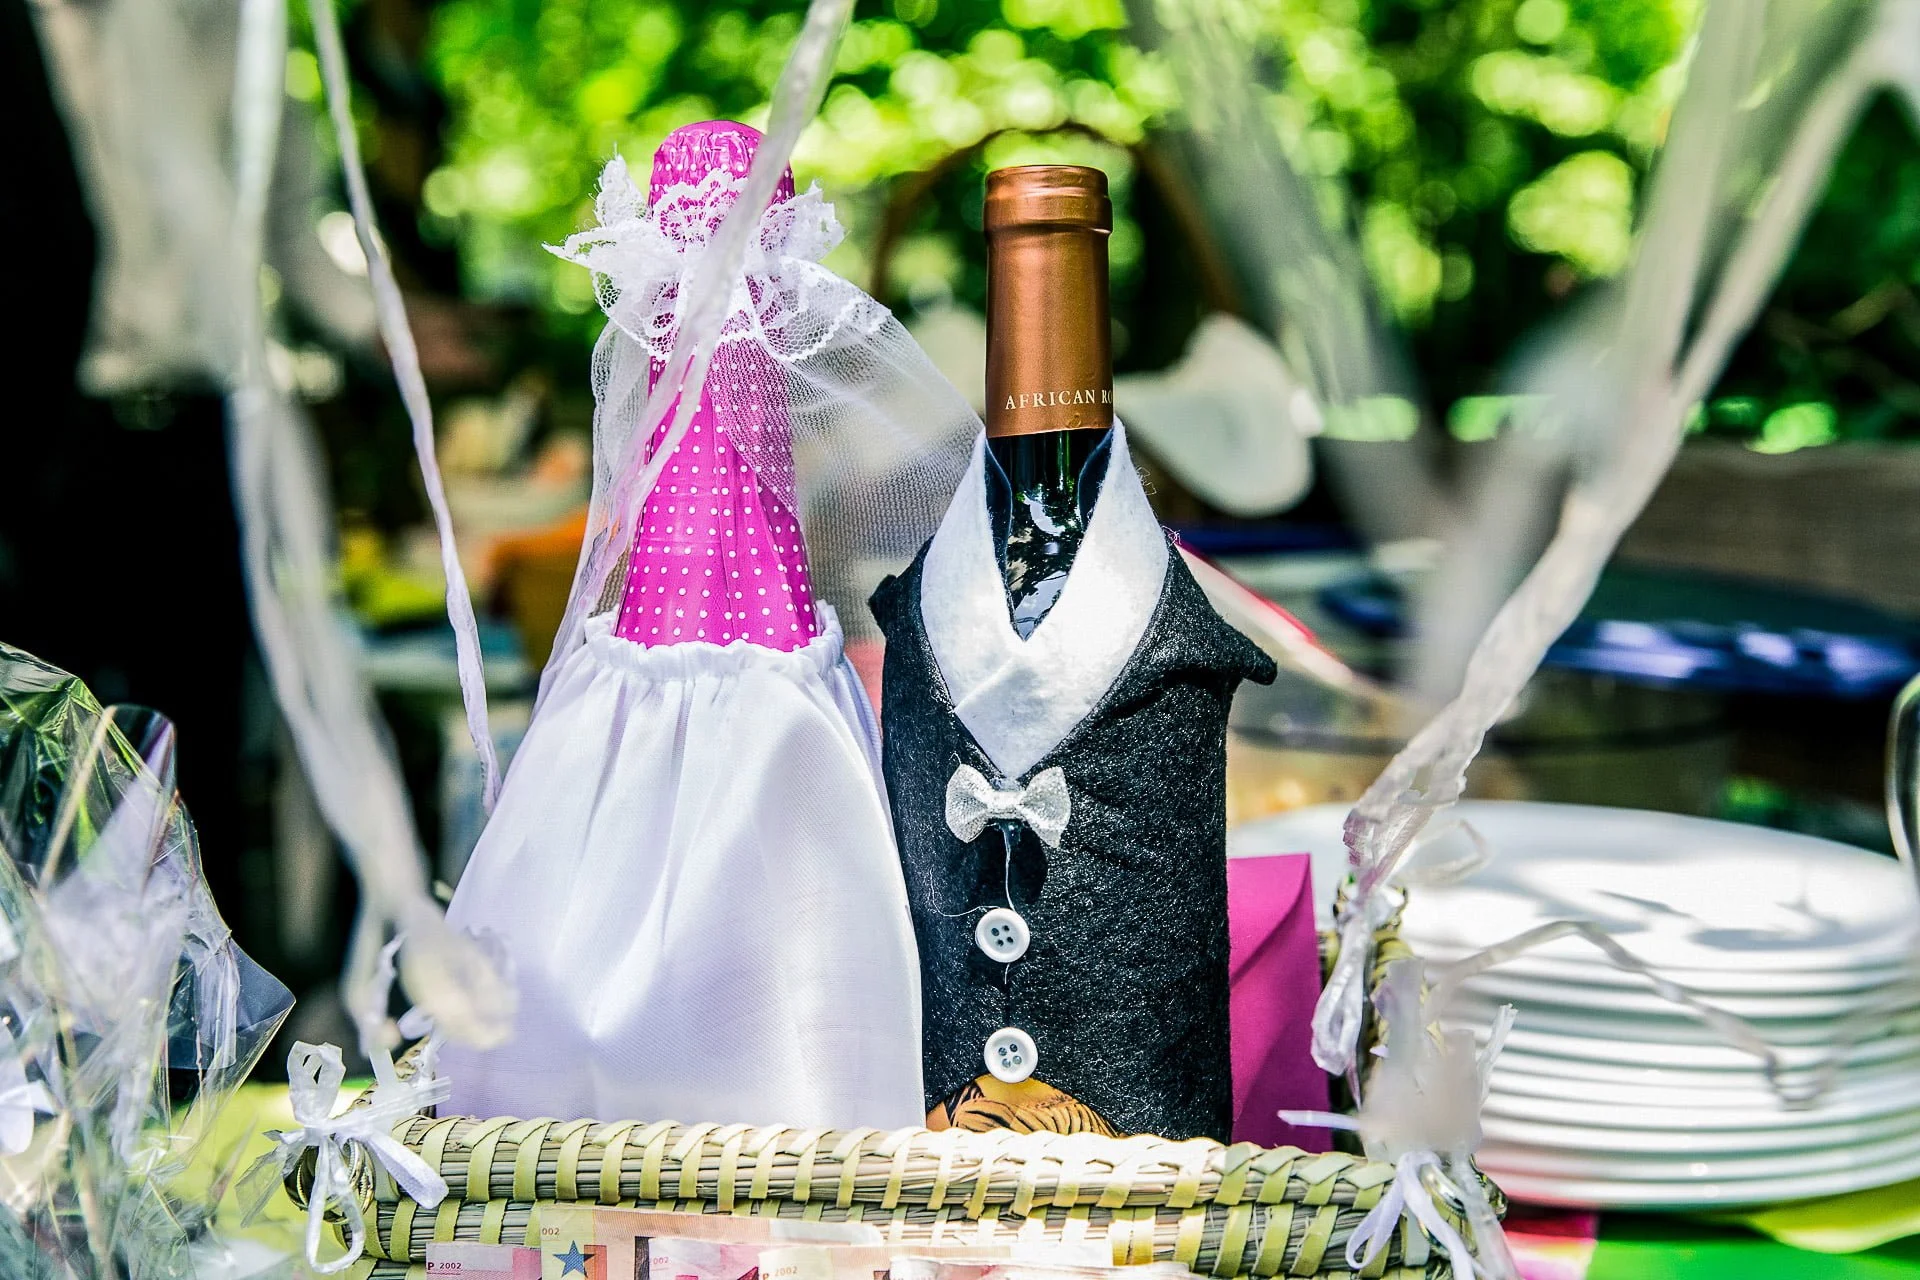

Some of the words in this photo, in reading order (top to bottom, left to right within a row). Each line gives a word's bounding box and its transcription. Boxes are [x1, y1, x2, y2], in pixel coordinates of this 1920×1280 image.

[1005, 389, 1096, 410] AFRICAN
[427, 1261, 435, 1271] P
[439, 1262, 462, 1270] 2002
[774, 1265, 798, 1277] 2002
